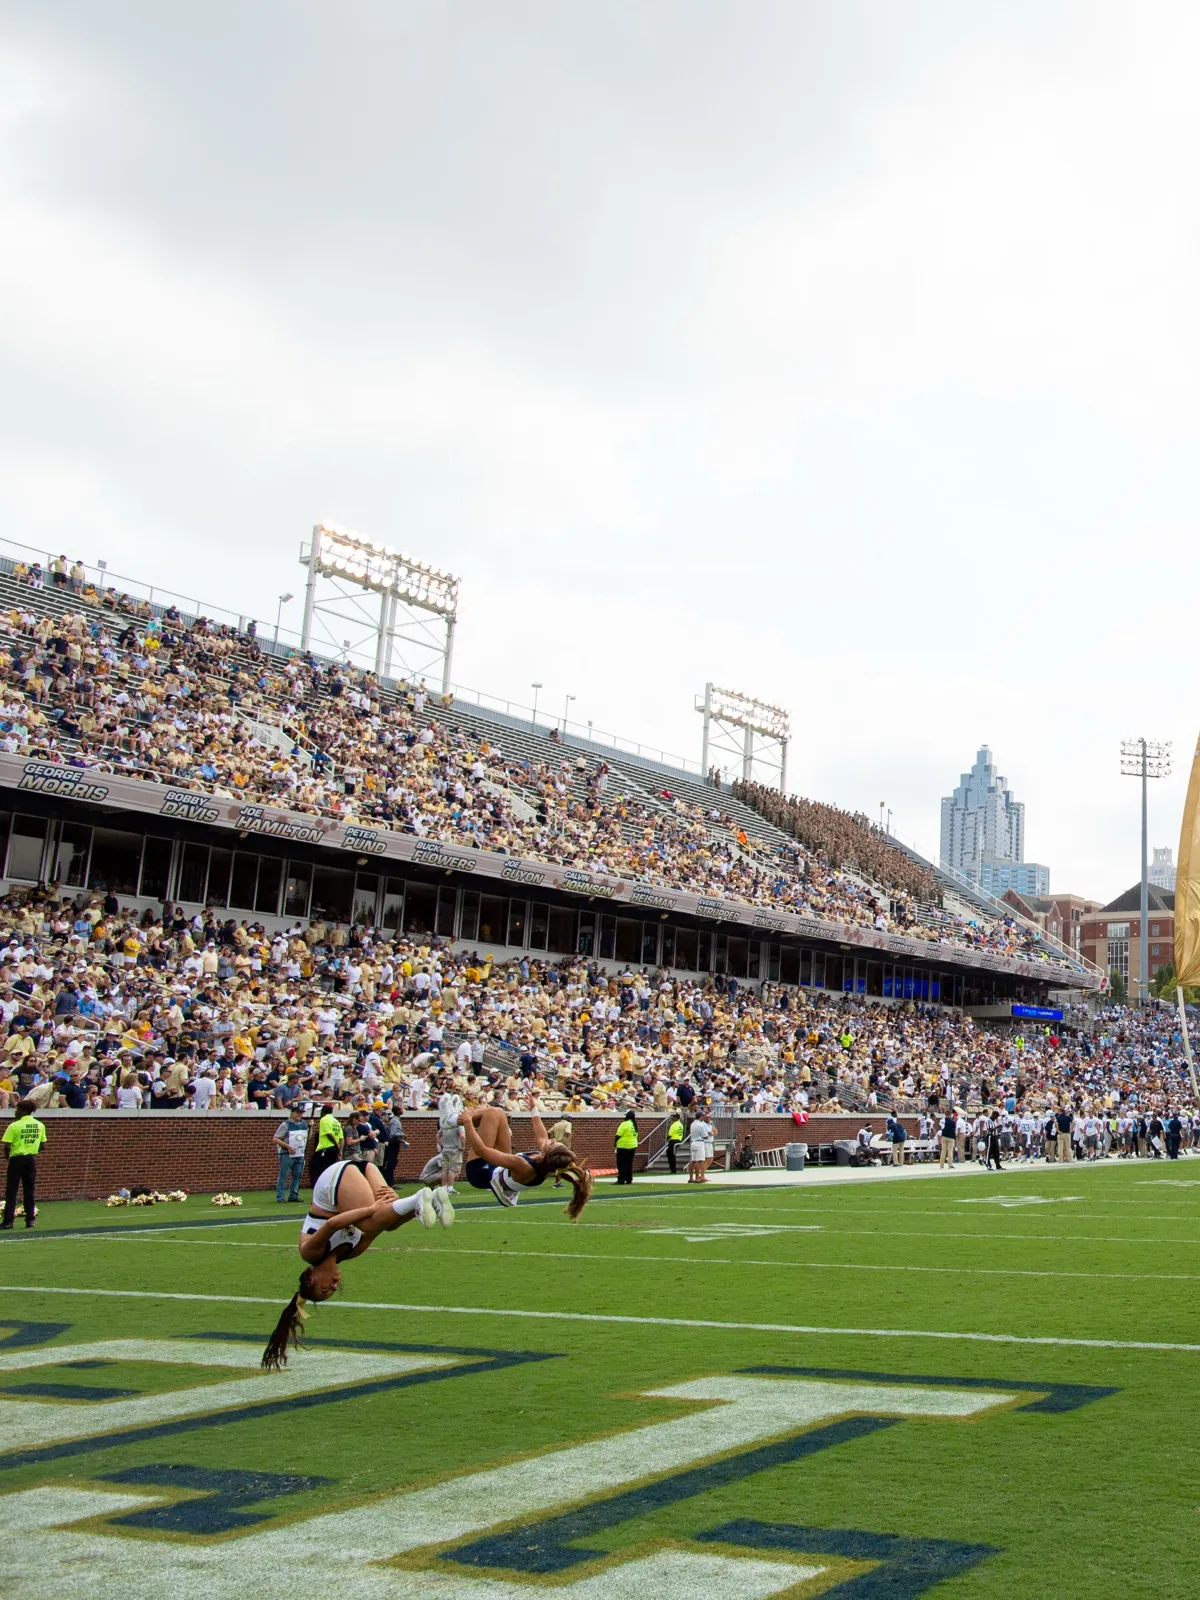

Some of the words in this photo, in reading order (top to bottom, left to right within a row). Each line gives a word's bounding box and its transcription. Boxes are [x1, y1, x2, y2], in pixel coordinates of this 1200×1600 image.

[24, 762, 84, 782] GEORGE
[18, 774, 109, 801] MORRIS
[165, 791, 210, 806] BOBBY
[160, 801, 219, 823] DAVIS
[240, 806, 262, 818] JOE
[235, 815, 323, 843] HAMILTON
[346, 827, 378, 840] PETER
[342, 835, 387, 854] PUND
[416, 841, 443, 852] BUCK
[411, 850, 476, 872] FLOWERS
[504, 859, 521, 869] JOE
[501, 868, 545, 884] GUYON
[564, 871, 590, 882] CALVIN
[561, 878, 615, 897] JOHNSON
[633, 885, 652, 895] JOHN
[630, 892, 677, 909] HEISMAN
[695, 905, 741, 922] STRUPPER
[751, 915, 788, 931] FINCHER
[795, 925, 839, 941] ALEXANDER
